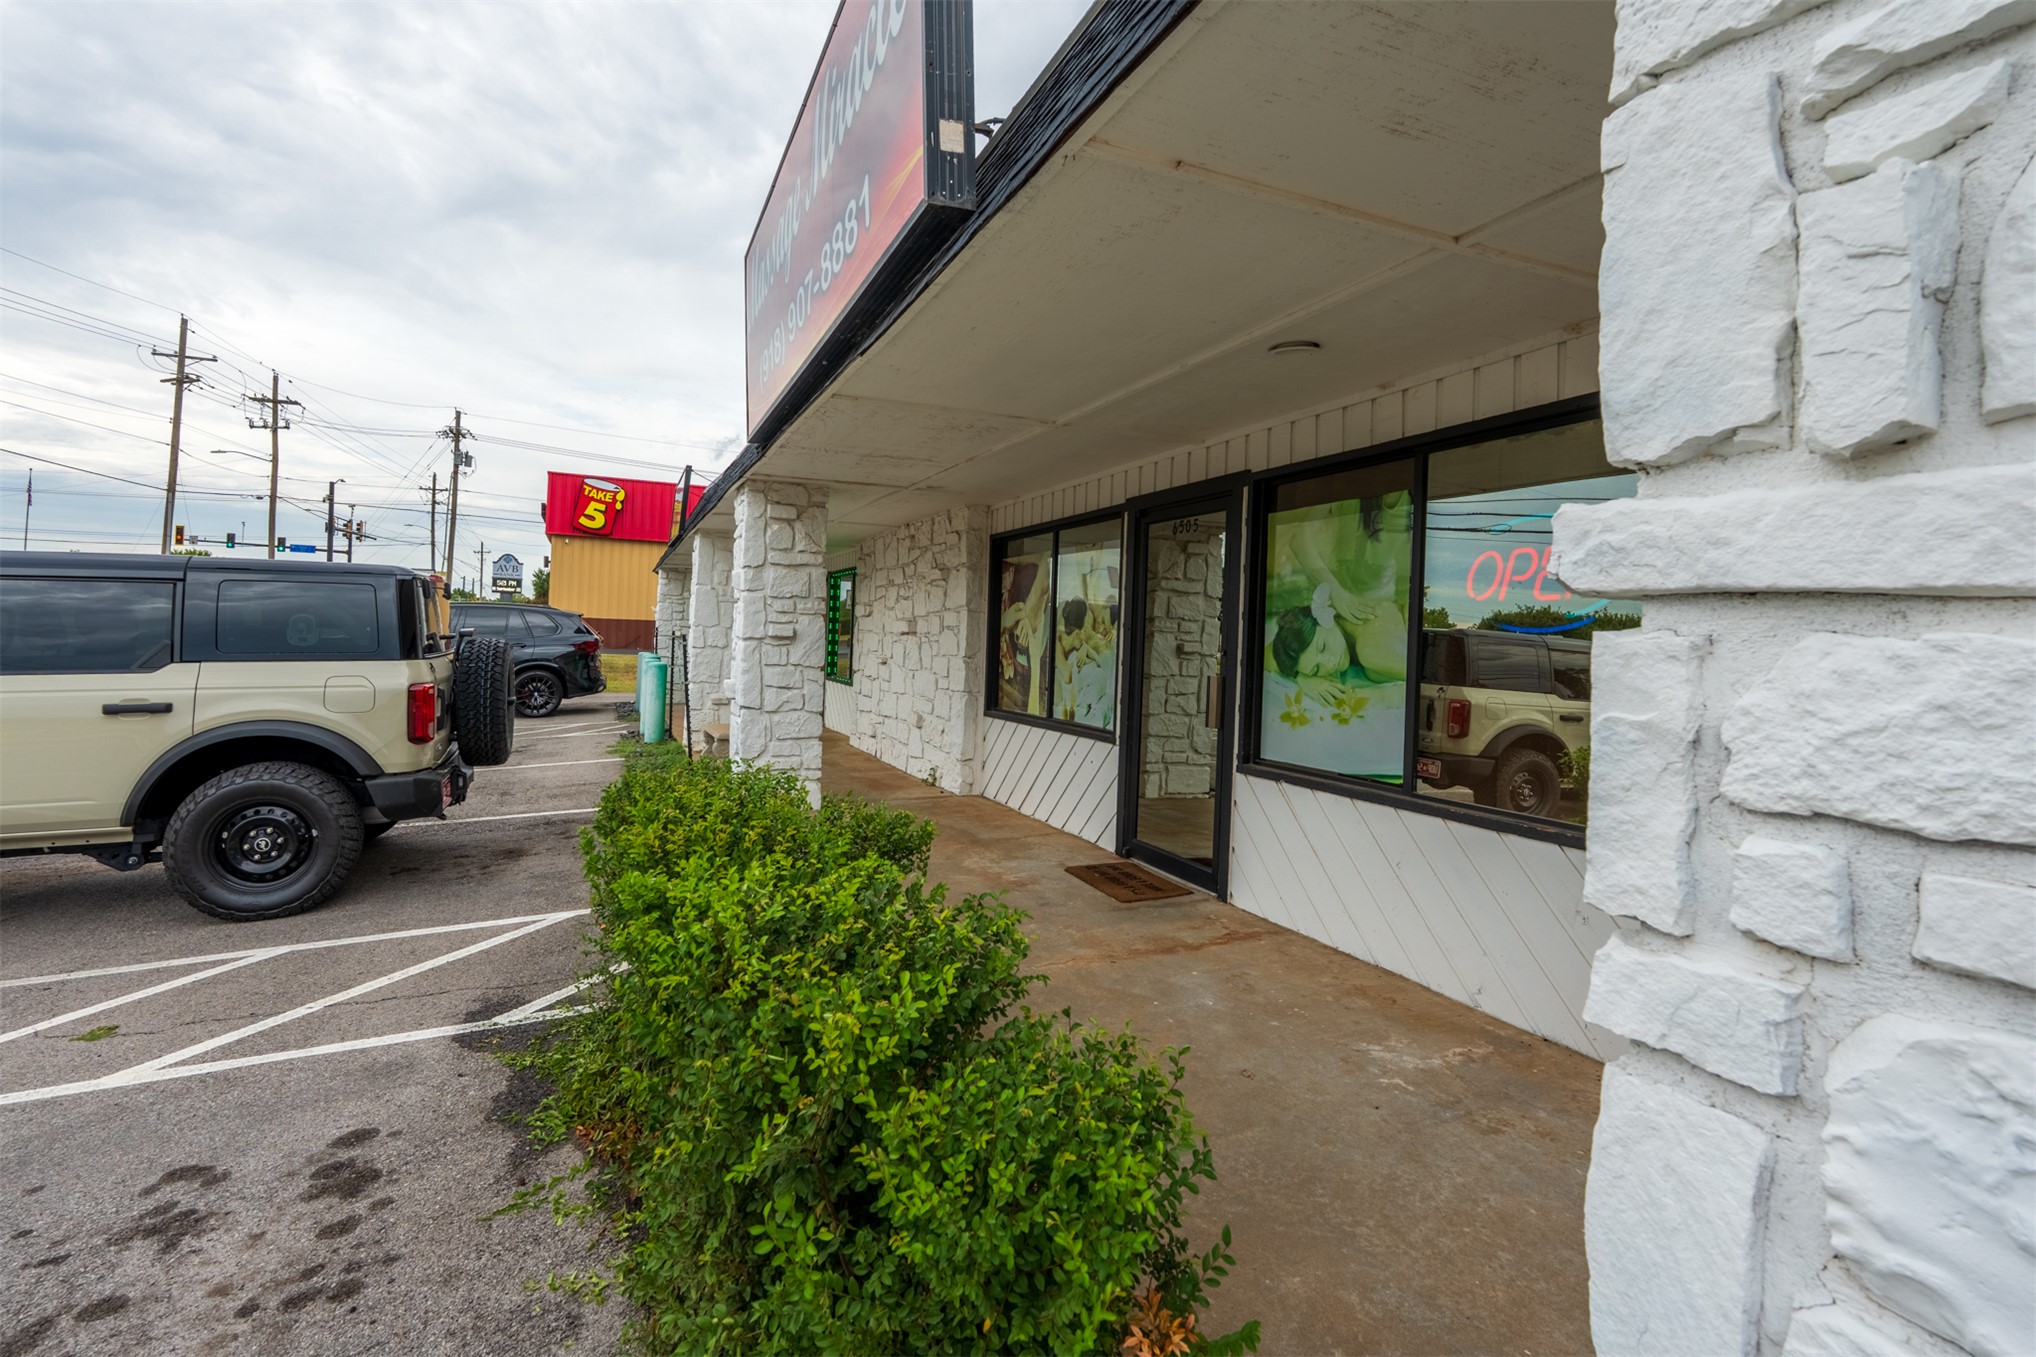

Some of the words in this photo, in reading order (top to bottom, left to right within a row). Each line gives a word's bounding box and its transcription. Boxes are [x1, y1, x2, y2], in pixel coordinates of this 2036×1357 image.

[759, 320, 787, 394] (918)
[787, 173, 871, 343] 907-8881
[583, 485, 614, 503] TAKE
[577, 501, 607, 529] 5
[1172, 518, 1199, 536] 6505
[496, 564, 519, 573] AVB
[1467, 545, 1572, 601] OPE
